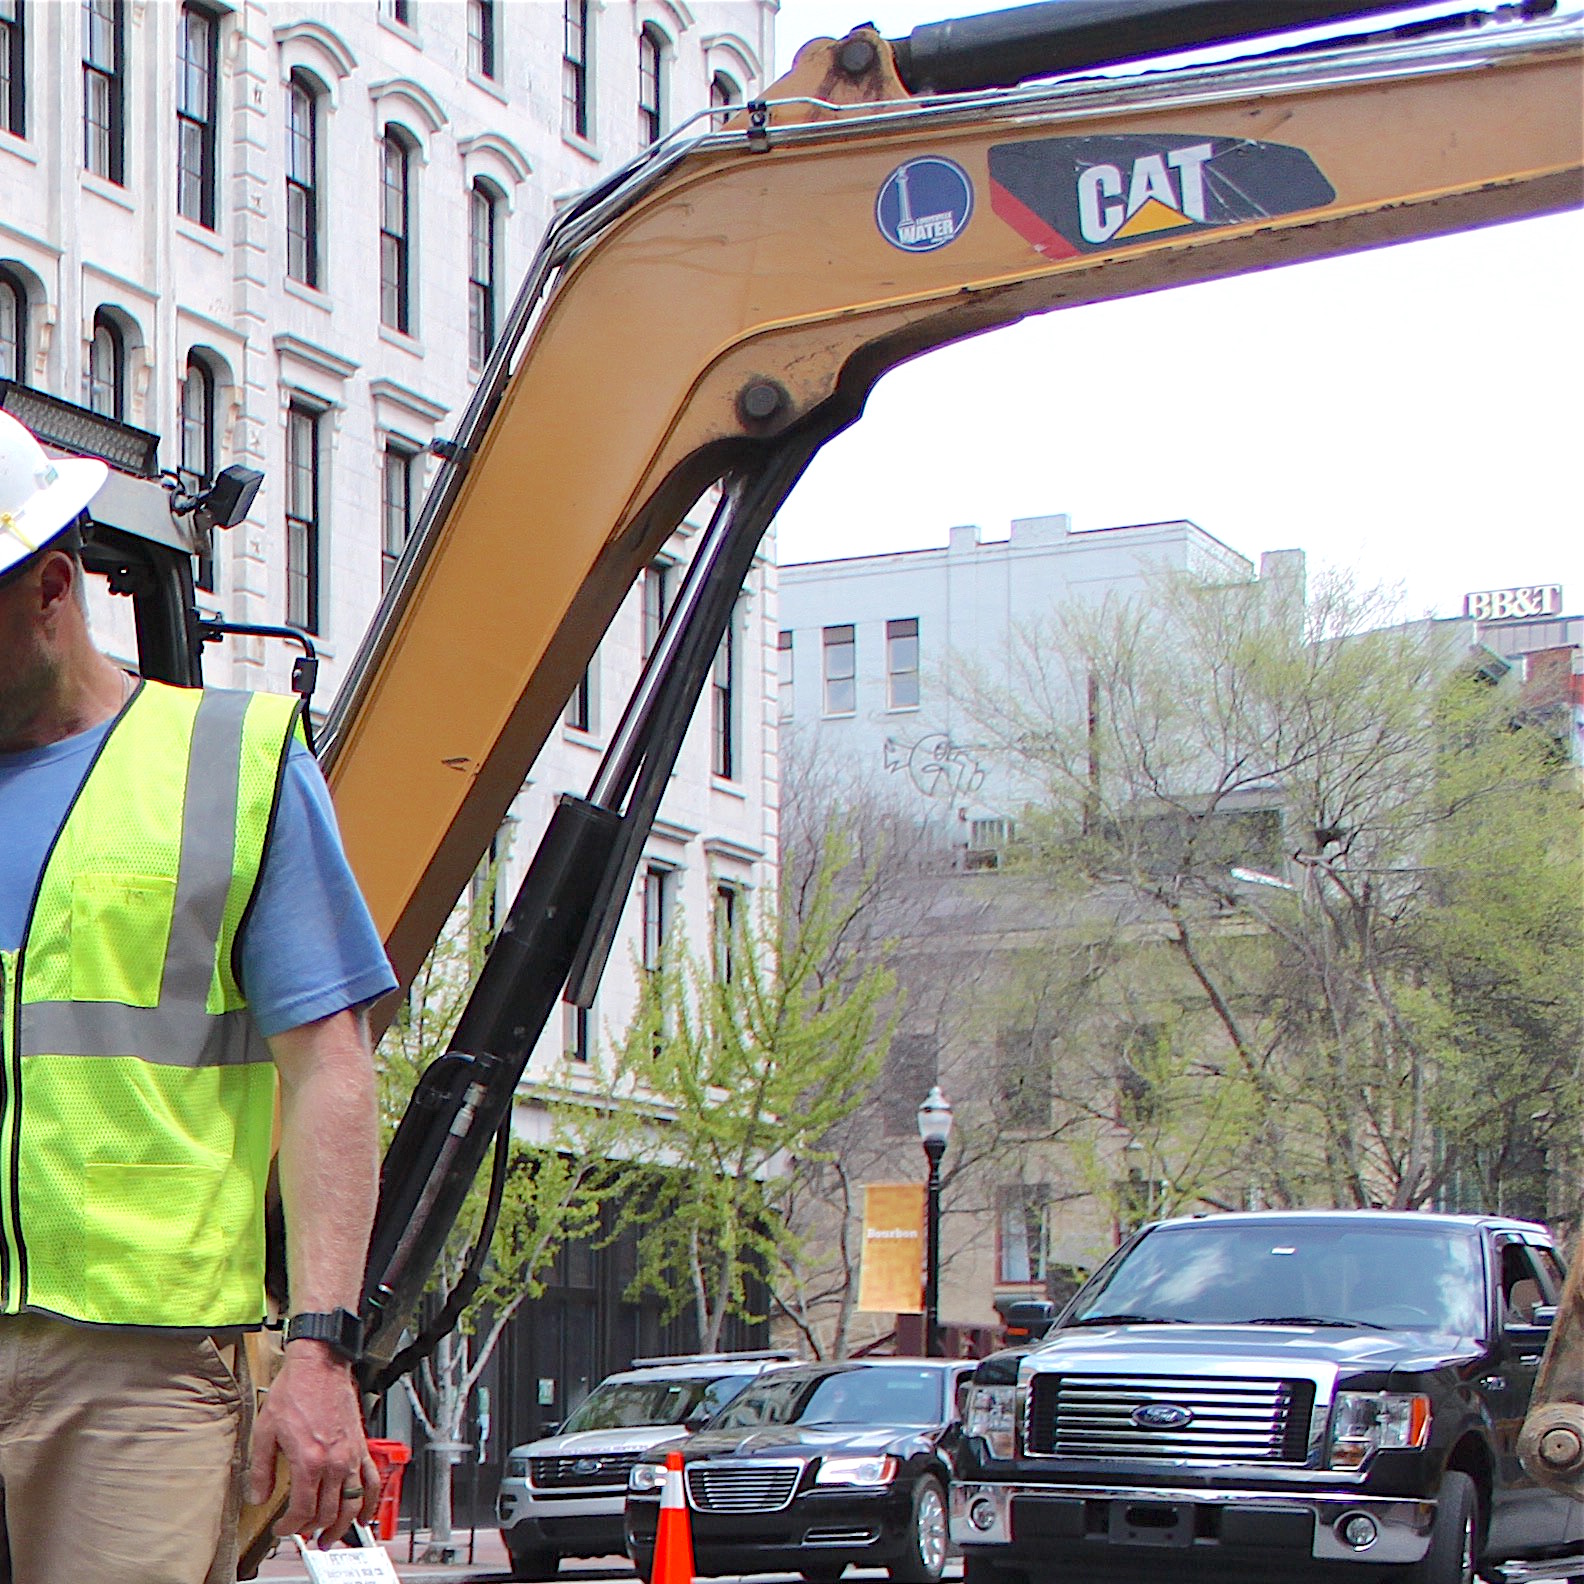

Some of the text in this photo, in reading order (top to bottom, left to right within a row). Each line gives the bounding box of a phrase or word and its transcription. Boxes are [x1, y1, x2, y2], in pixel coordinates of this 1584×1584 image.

[1078, 143, 1212, 244] CAT
[899, 219, 953, 244] WATER
[1468, 586, 1560, 621] BB&T
